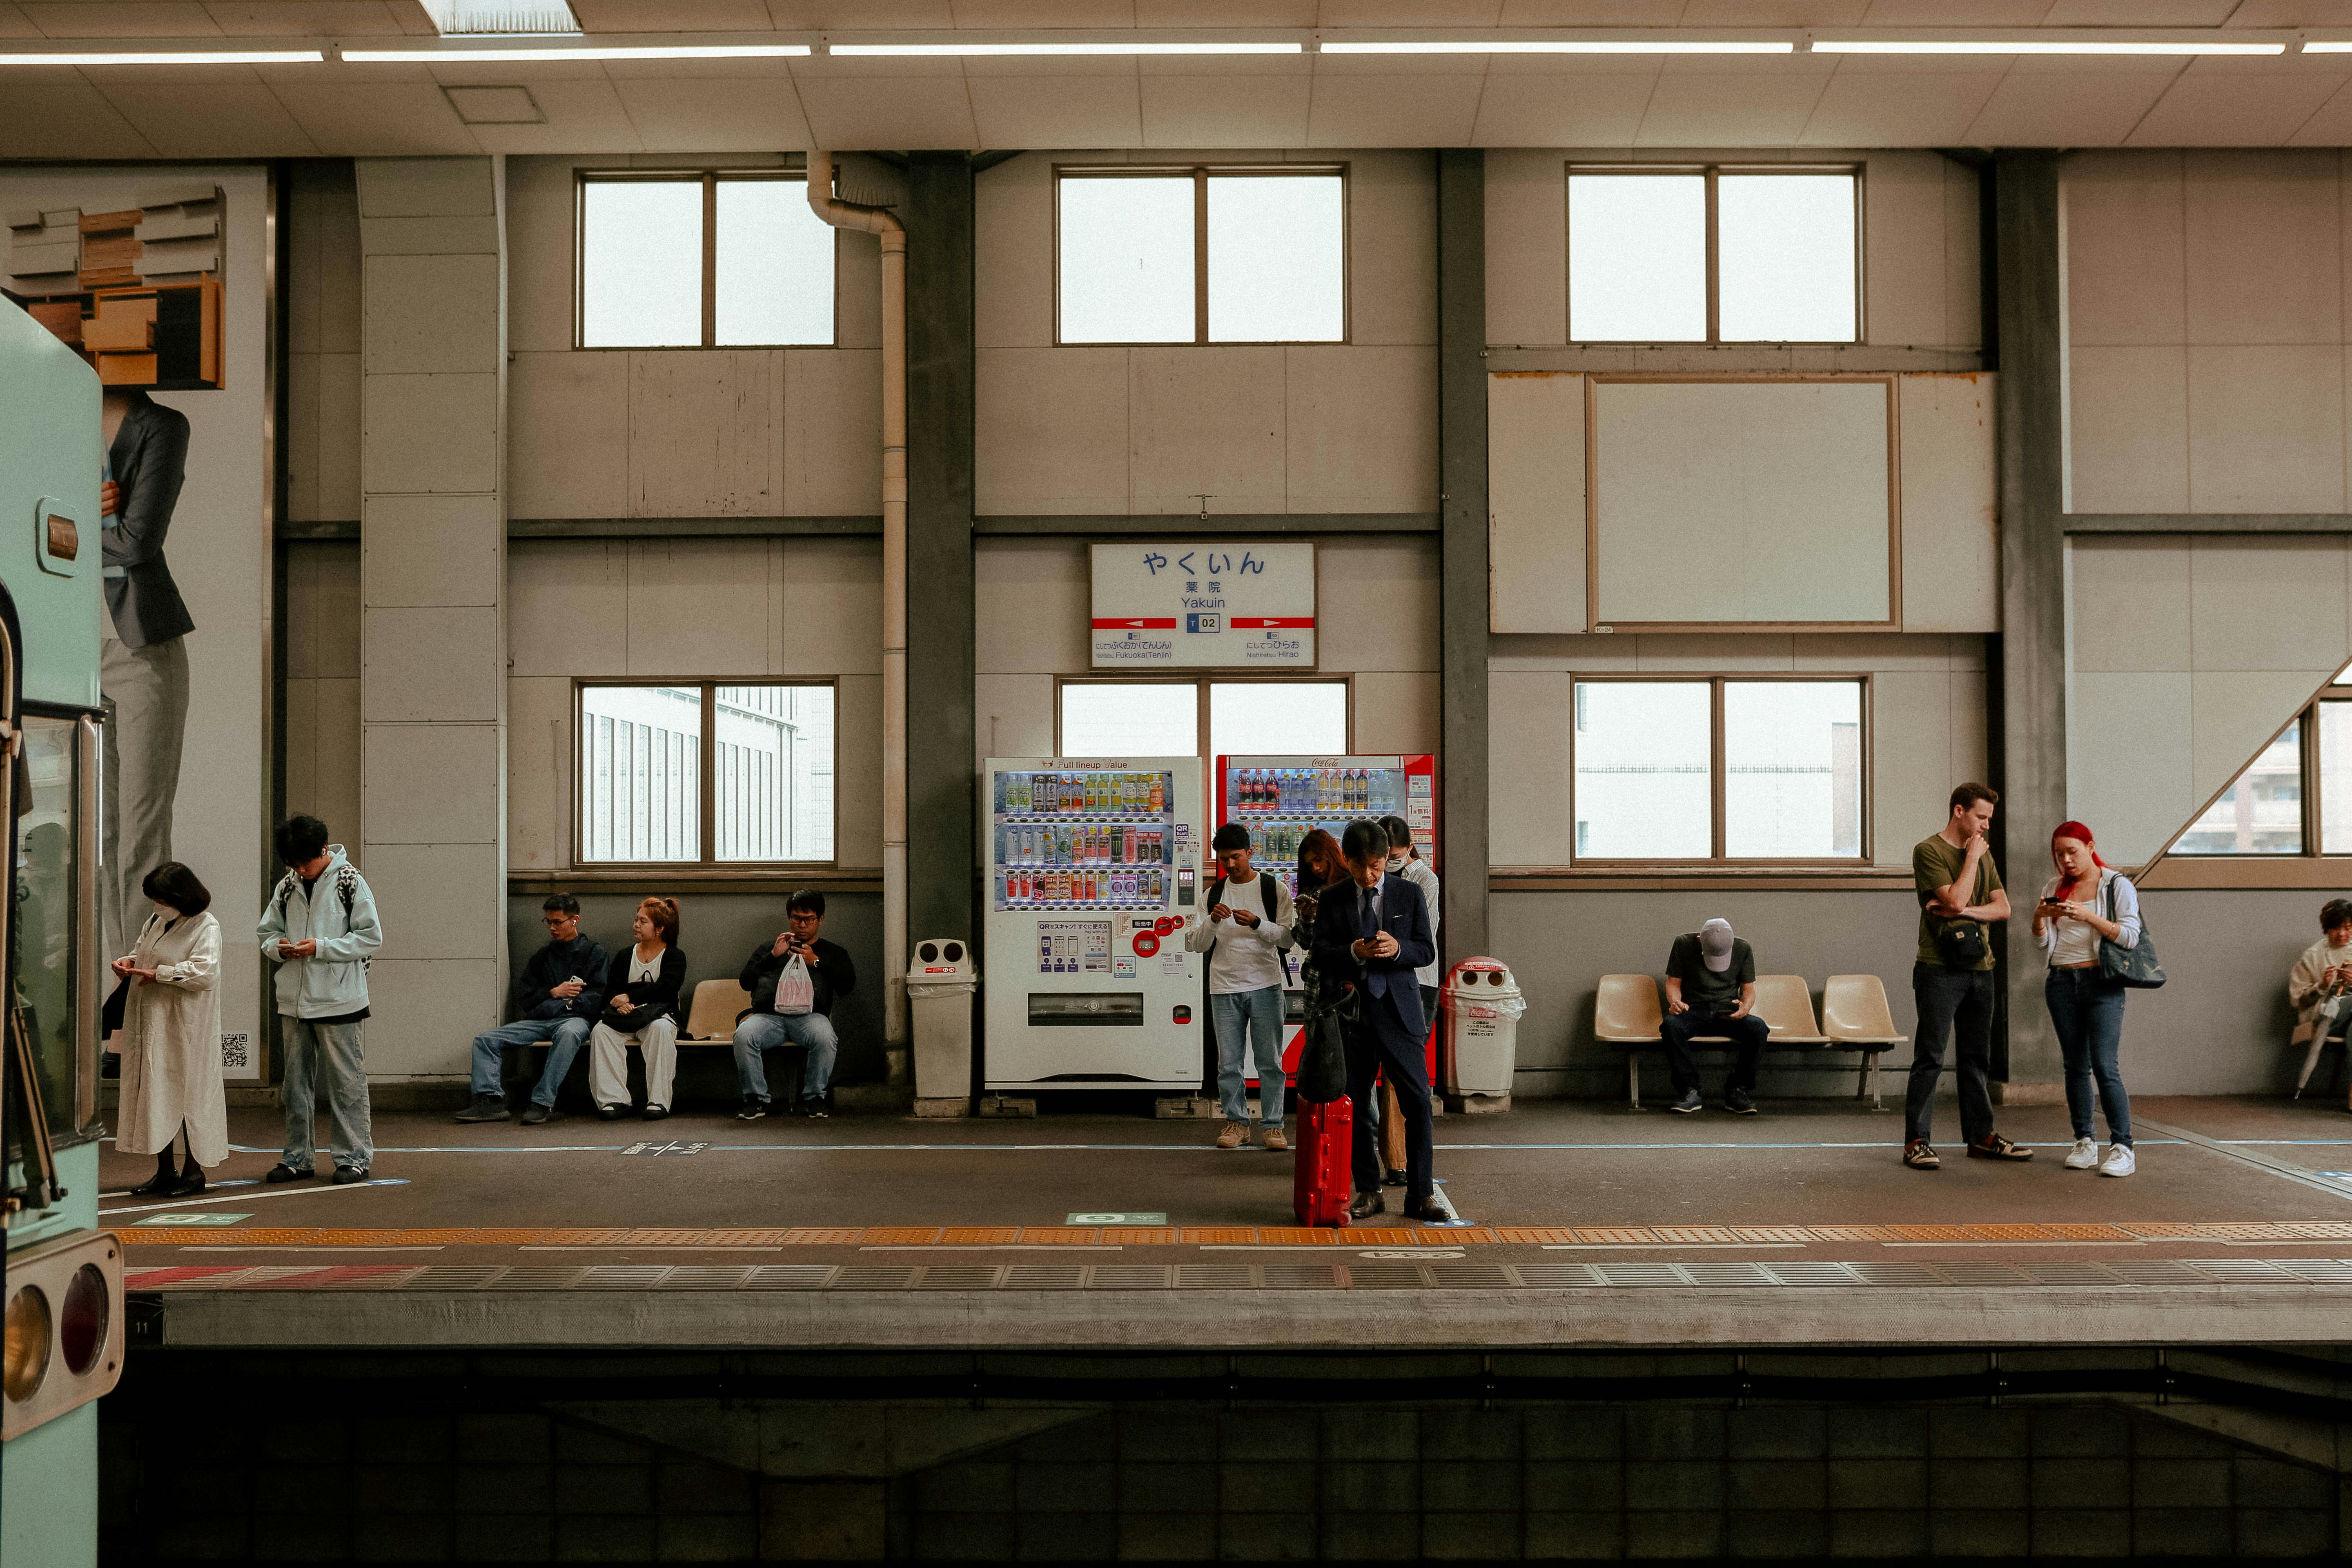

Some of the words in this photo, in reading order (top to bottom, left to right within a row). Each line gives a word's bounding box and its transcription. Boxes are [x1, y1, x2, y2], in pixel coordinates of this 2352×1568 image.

[1143, 552, 1264, 575] やくいん
[1181, 597, 1225, 608] Yakuin
[1202, 619, 1215, 627] 02
[1247, 640, 1299, 649] にしてつひらお
[1058, 759, 1073, 768] Full
[1103, 759, 1127, 768] Value
[136, 1321, 147, 1334] 11
